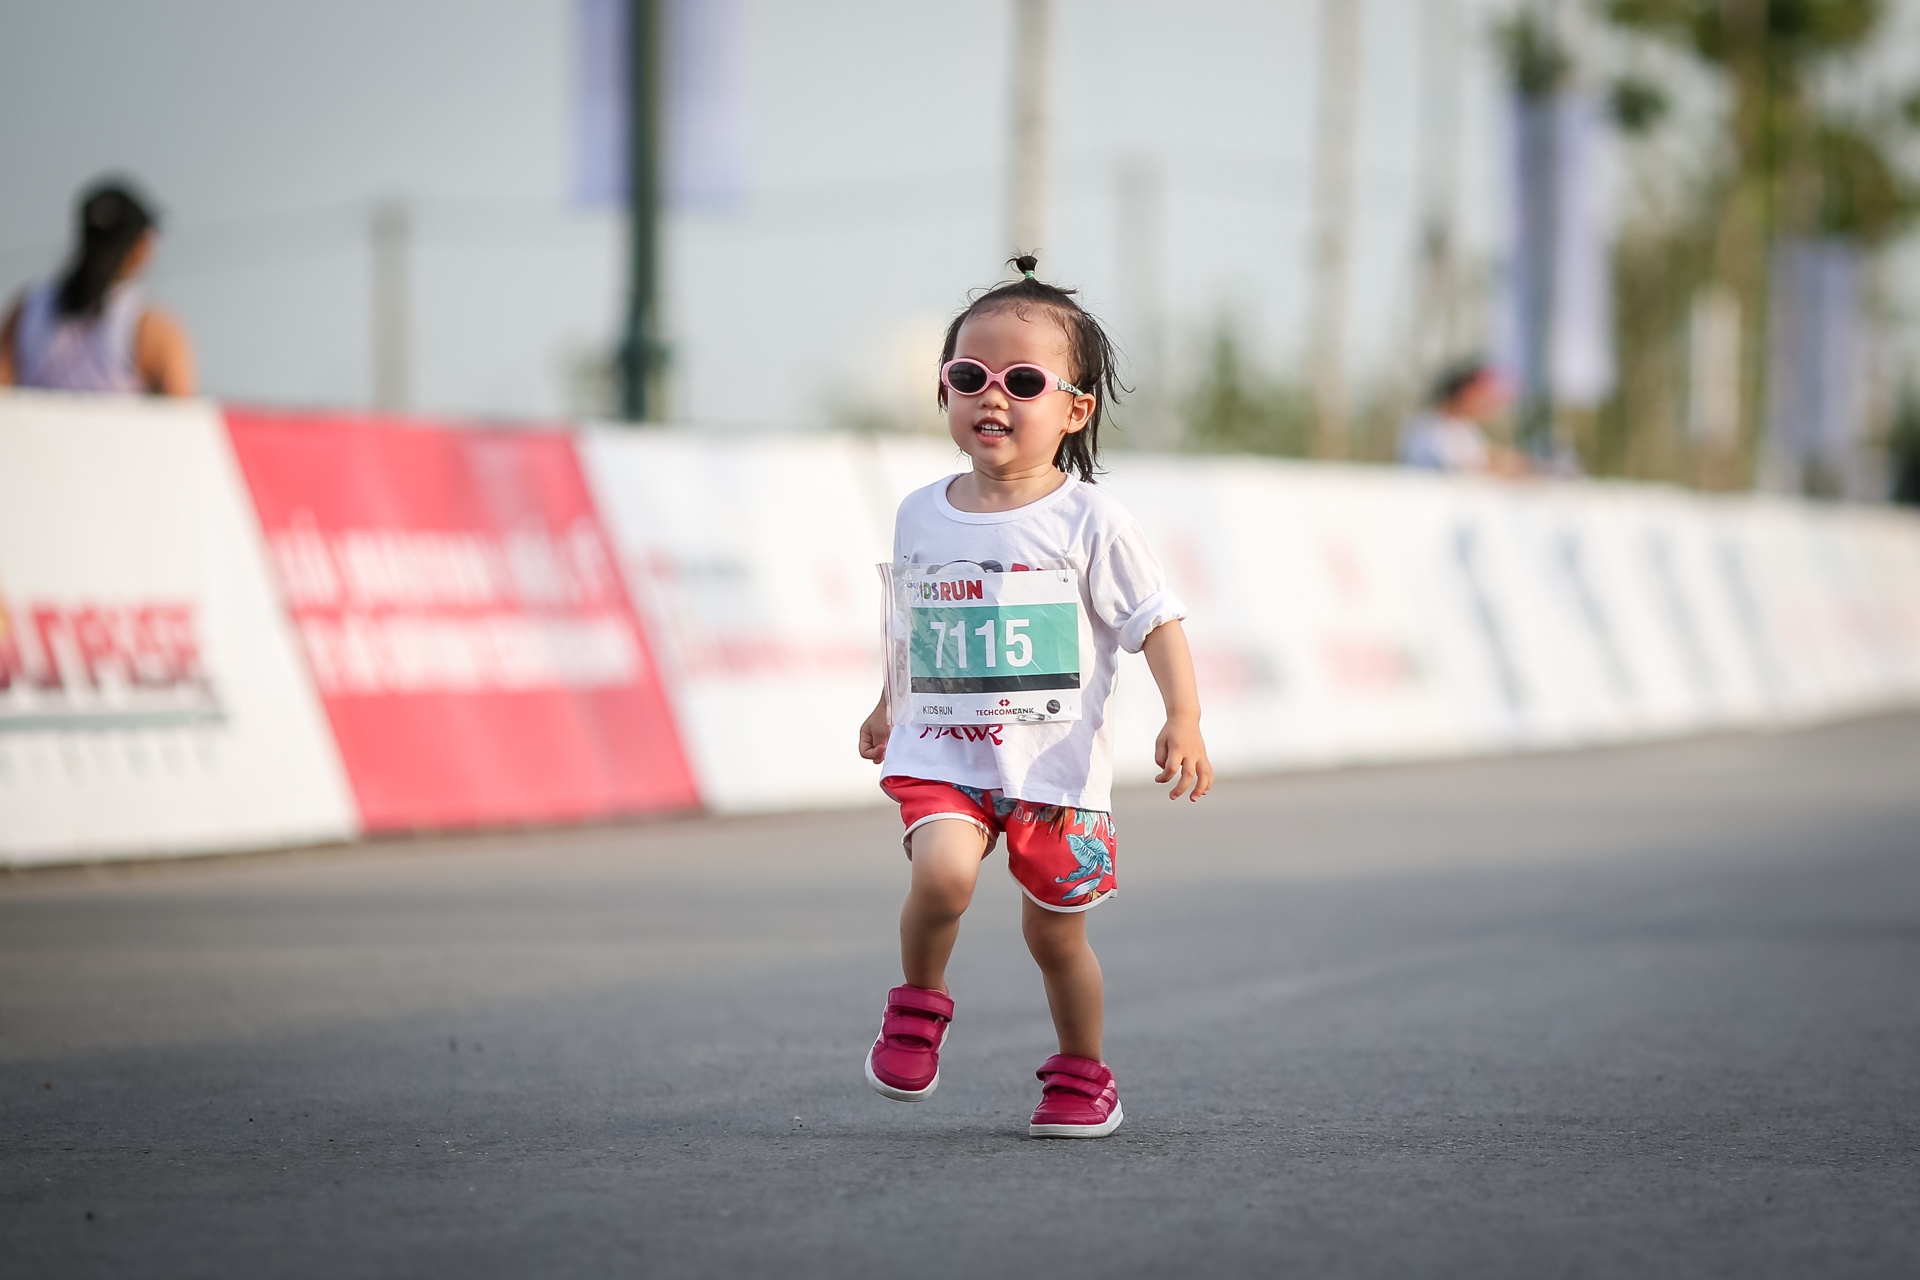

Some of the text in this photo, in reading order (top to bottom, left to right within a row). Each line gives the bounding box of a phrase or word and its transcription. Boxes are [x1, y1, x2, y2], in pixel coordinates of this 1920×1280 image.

[929, 618, 1033, 669] 7115
[922, 705, 953, 716] KIDS RUN
